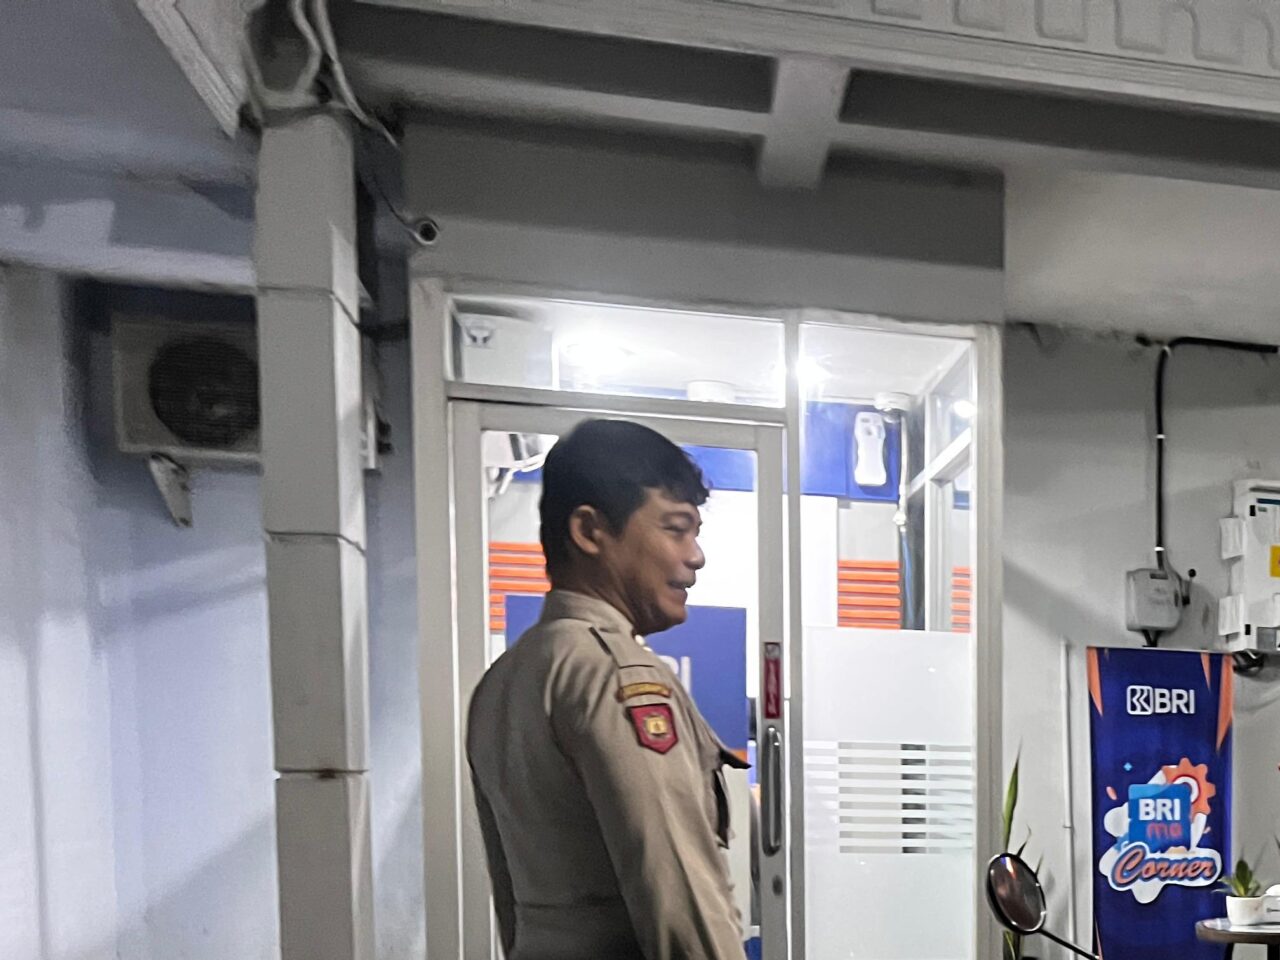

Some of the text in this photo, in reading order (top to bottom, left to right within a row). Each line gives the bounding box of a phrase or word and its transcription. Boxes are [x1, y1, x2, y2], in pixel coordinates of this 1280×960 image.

[1154, 688, 1195, 714] BRI
[1139, 798, 1181, 821] BRI
[1113, 845, 1216, 887] Corner
